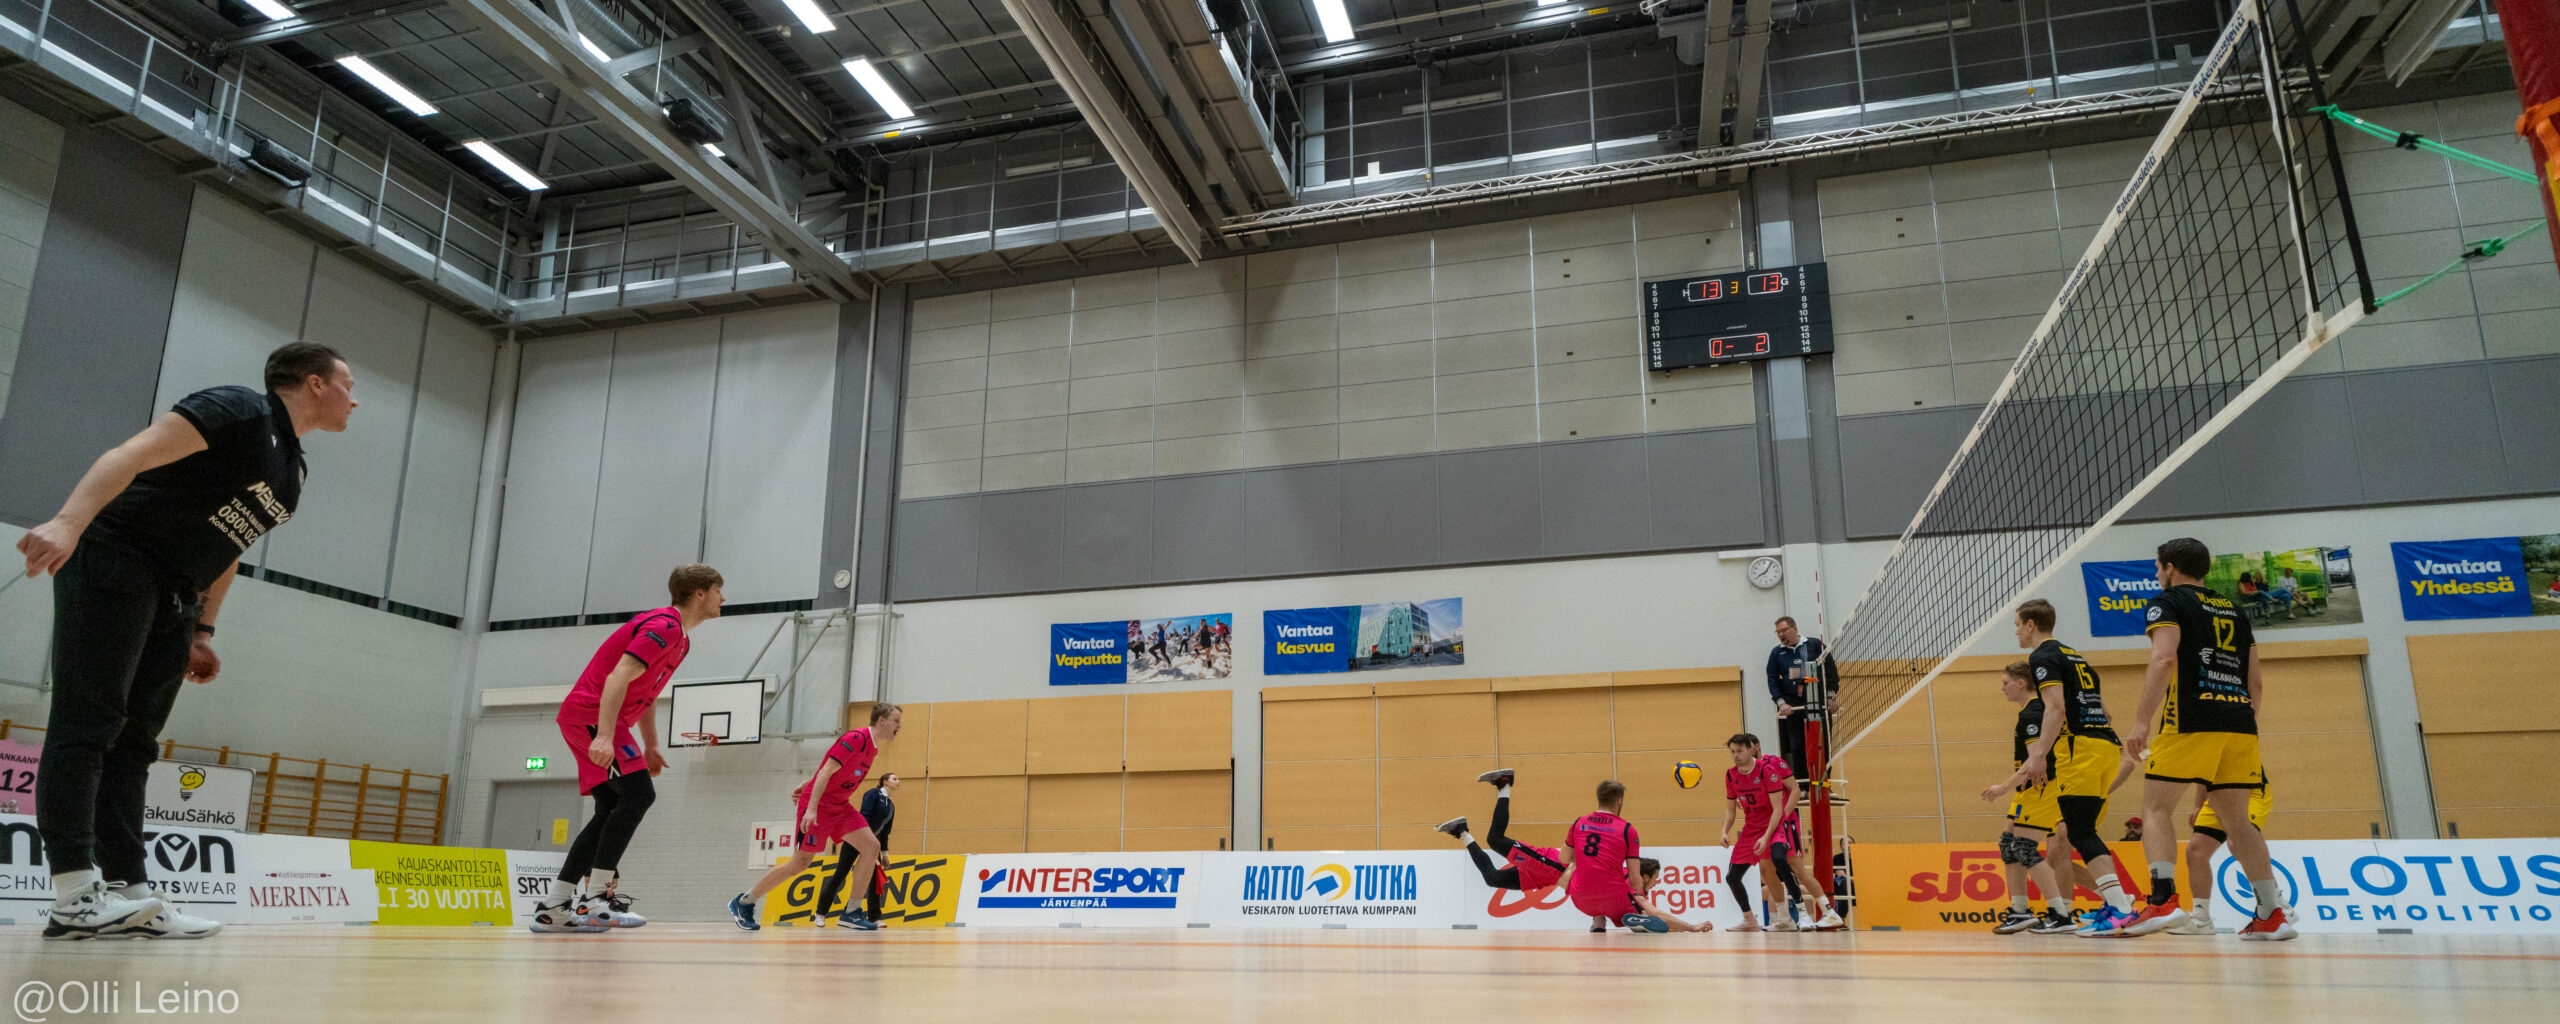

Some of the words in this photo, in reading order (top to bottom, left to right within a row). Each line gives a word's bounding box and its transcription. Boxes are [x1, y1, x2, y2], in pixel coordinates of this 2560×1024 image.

[2116, 152, 2156, 217] Rakennuslehti
[1682, 289, 1689, 297] H
[1702, 282, 1719, 298] 13
[1730, 281, 1739, 294] 3
[1763, 275, 1779, 291] 13
[1780, 278, 1788, 286] G
[1755, 335, 1766, 352] 2
[231, 497, 251, 517] TILAA
[218, 505, 248, 534] 0800
[208, 515, 229, 533] Koko
[227, 530, 248, 552] Suom
[2413, 559, 2502, 576] Vantaa
[2410, 575, 2516, 597] Yhdessä
[1276, 624, 1334, 639] Vantaa
[2213, 616, 2237, 652] 12
[1063, 637, 1115, 651] Vantaa
[1276, 641, 1335, 656] Kasvua
[1055, 652, 1123, 668] Vapautta
[2075, 663, 2094, 689] 15
[0, 753, 41, 766] ANKAANP
[0, 768, 36, 794] 12
[1745, 793, 1757, 805] 13
[144, 805, 236, 825] akuuSähkö
[1584, 833, 1601, 856] 8
[277, 871, 320, 879] Kotileipomo
[397, 857, 501, 874] KAUASKANTOISTA
[2302, 855, 2560, 896] LOTUS
[375, 871, 503, 888] KENNESUUNNITTELUA
[517, 876, 552, 895] SRT
[1008, 867, 1185, 893] INTERSPORT
[1243, 865, 1305, 901] KATTO
[1354, 864, 1417, 900] TUTKA
[249, 885, 350, 907] MERINTA
[406, 888, 429, 909] 30
[435, 890, 505, 910] VUOTTA
[786, 872, 941, 908] GRNO
[1040, 897, 1108, 908] JÄRVENPÄÄ
[1242, 905, 1295, 916] VESIKATON
[1298, 905, 1359, 916] LUOTETTAVA
[1362, 905, 1417, 916] KUMPPANI
[2317, 904, 2552, 921] DEMOLITIO
